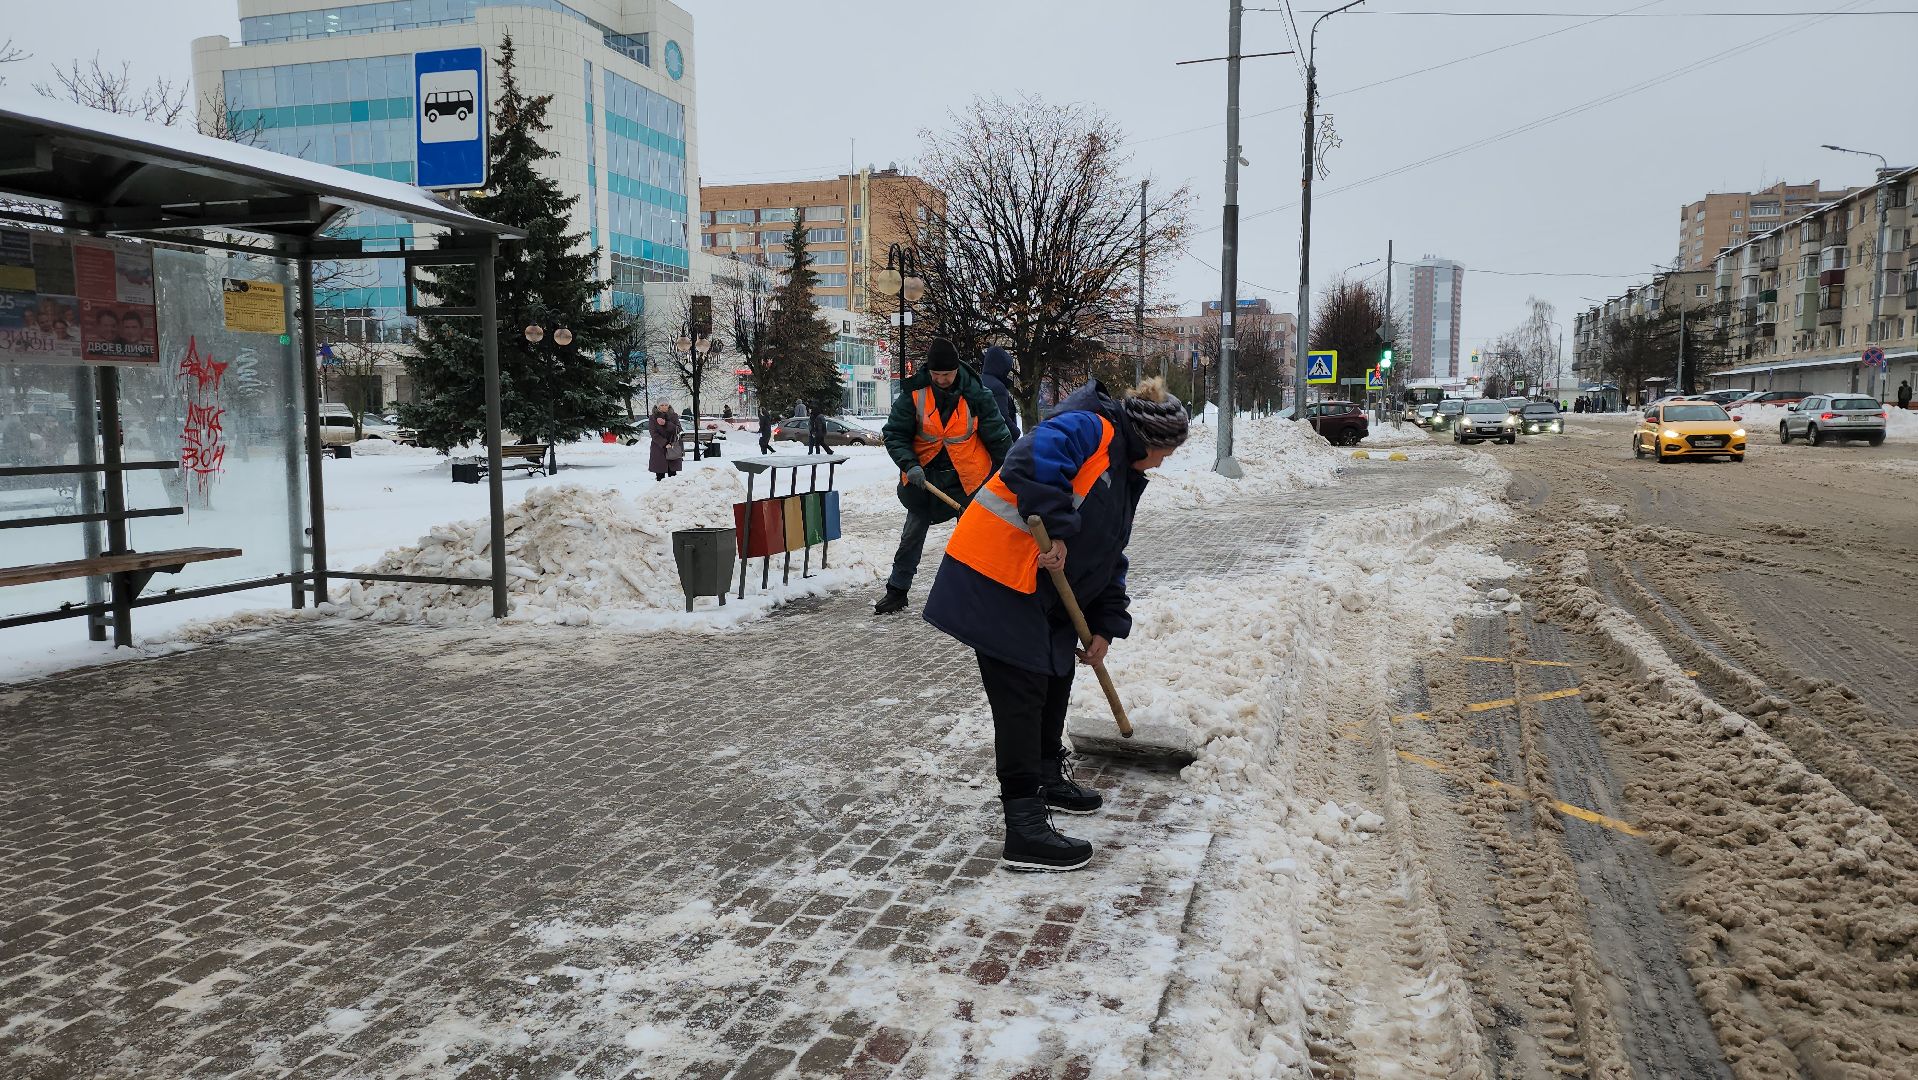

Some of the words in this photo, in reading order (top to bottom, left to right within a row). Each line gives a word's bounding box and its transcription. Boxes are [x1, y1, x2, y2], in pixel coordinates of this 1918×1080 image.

[87, 341, 115, 352] ДВОЕ
[115, 343, 122, 353] В
[124, 343, 155, 354] ЛИФТЕ
